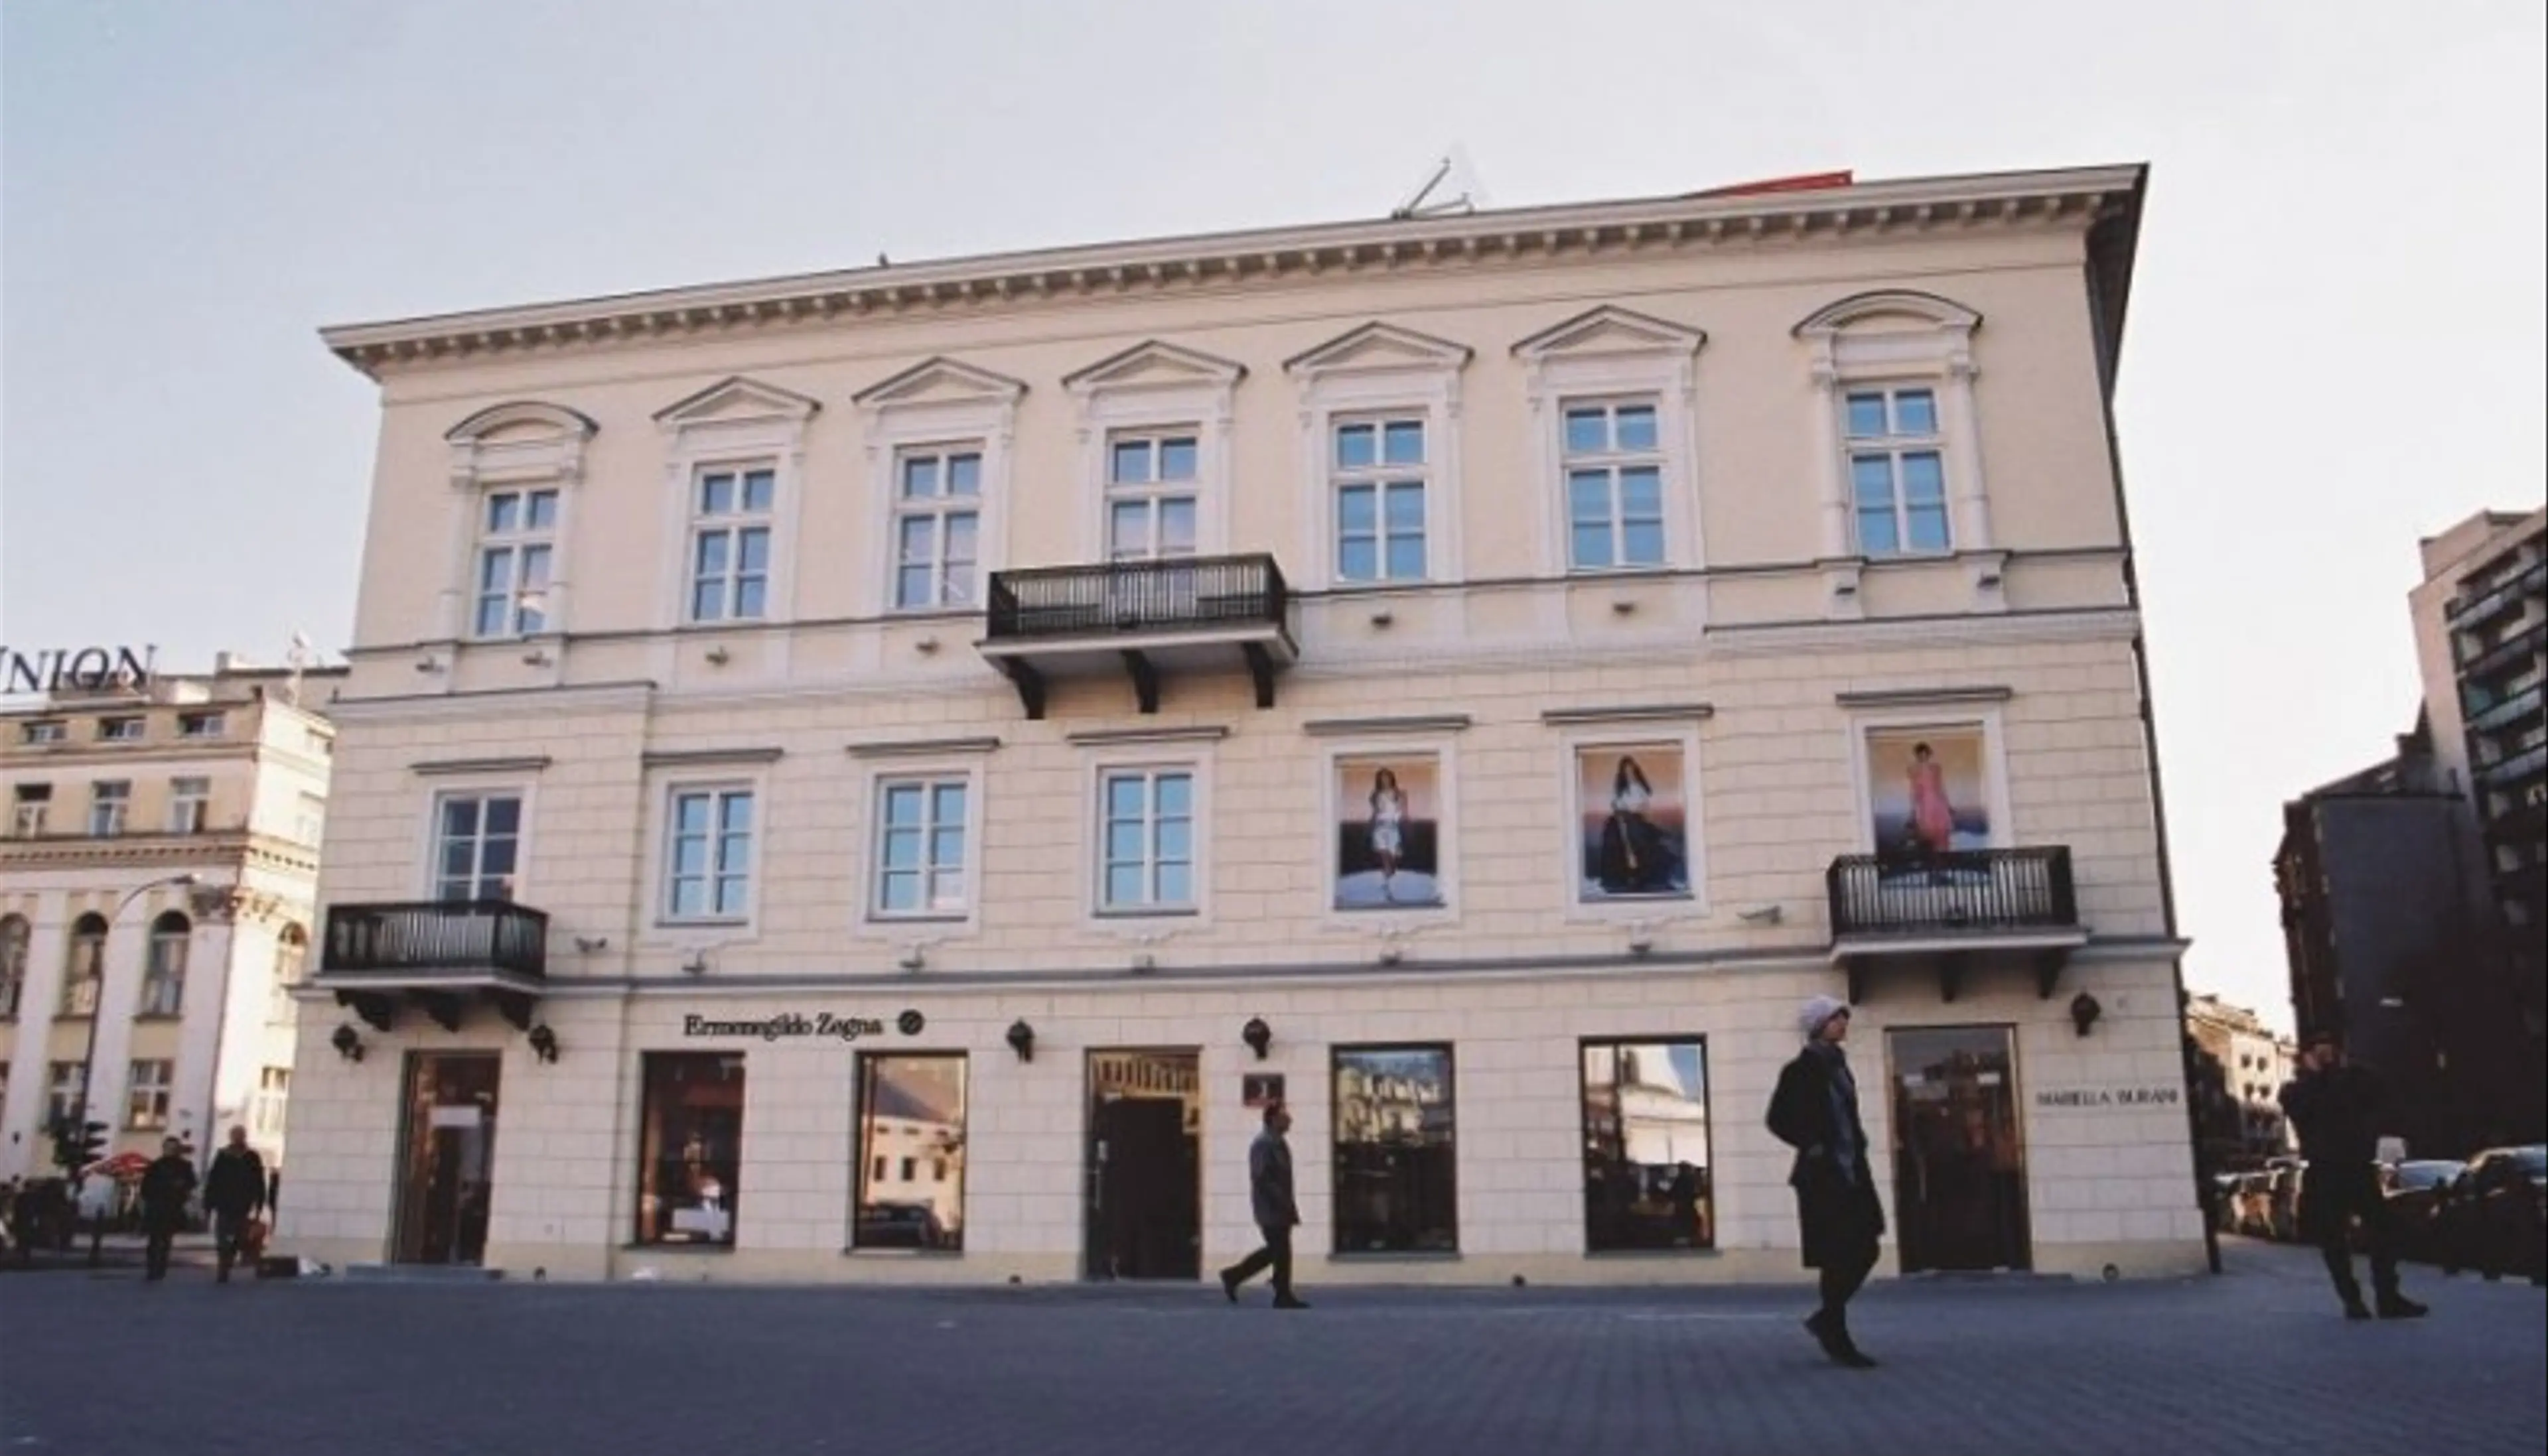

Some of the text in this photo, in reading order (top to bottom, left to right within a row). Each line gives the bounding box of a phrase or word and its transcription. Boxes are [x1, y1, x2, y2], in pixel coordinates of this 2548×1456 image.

[0, 643, 158, 693] NION
[684, 1012, 883, 1041] Ermenegildo Zegna
